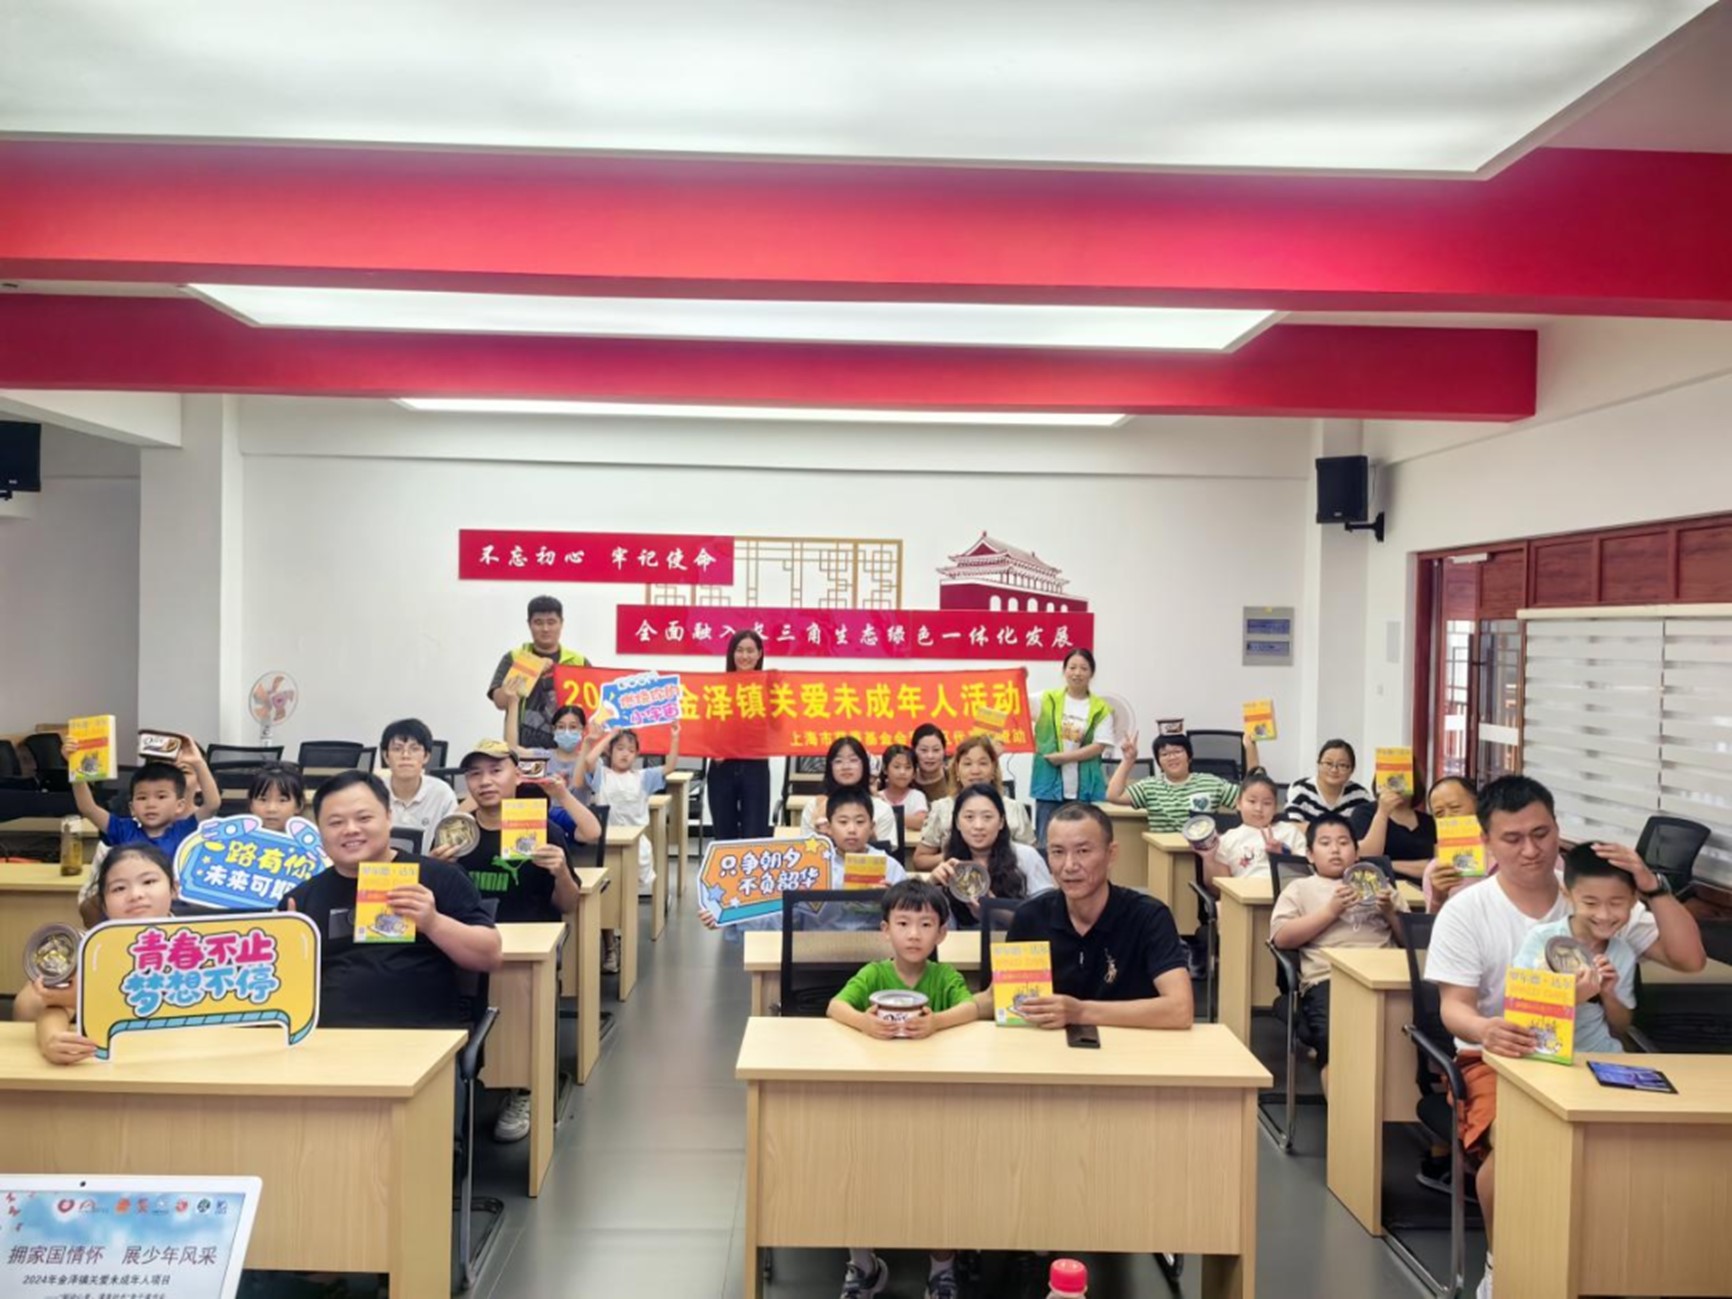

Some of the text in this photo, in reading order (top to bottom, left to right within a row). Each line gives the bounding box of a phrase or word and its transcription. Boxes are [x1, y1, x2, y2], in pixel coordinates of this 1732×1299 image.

[478, 545, 716, 571] 不忘初心 牢记使命
[204, 840, 317, 880] 一路有你
[719, 847, 802, 877] 只争朝夕
[738, 866, 820, 896] 不负韶华
[130, 928, 276, 971] 青春不止
[123, 963, 278, 1015] 梦想不停
[7, 1245, 218, 1266] 拥家国情怀 展少年风采
